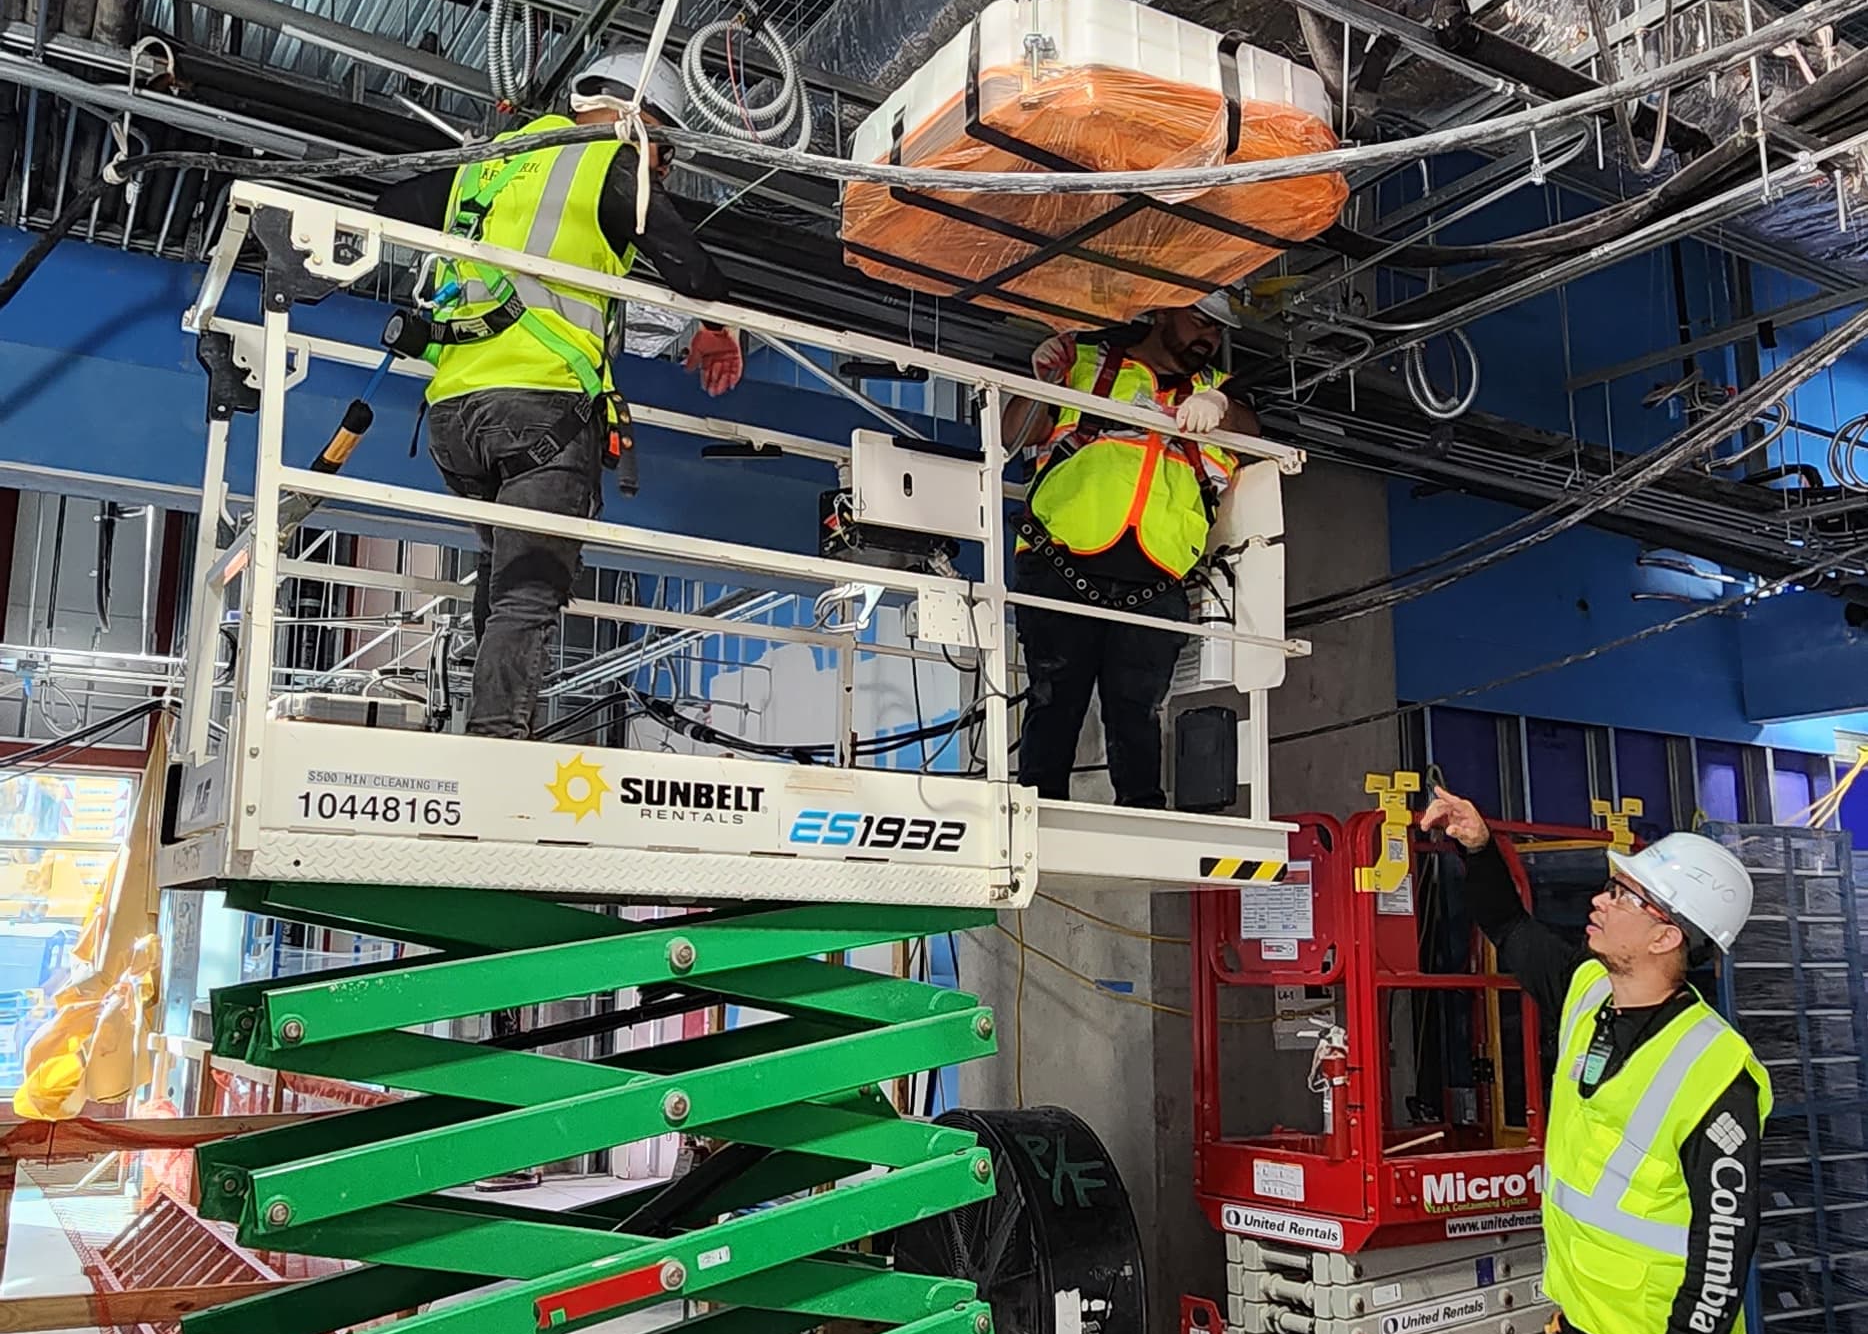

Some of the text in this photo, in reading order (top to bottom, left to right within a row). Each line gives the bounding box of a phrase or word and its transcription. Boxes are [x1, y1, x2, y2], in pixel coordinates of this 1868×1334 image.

[344, 775, 367, 786] MIN
[373, 776, 431, 791] CLEANING
[437, 781, 460, 793] FEE
[620, 777, 765, 813] SUNBELT
[298, 791, 462, 827] 10448165
[640, 808, 744, 825] RENTALS
[789, 809, 967, 853] ES1932
[1422, 1164, 1547, 1205] Micro1
[1243, 1213, 1339, 1242] United Rentals
[1689, 1156, 1747, 1334] Columbia
[1401, 1299, 1484, 1331] United Rentals
